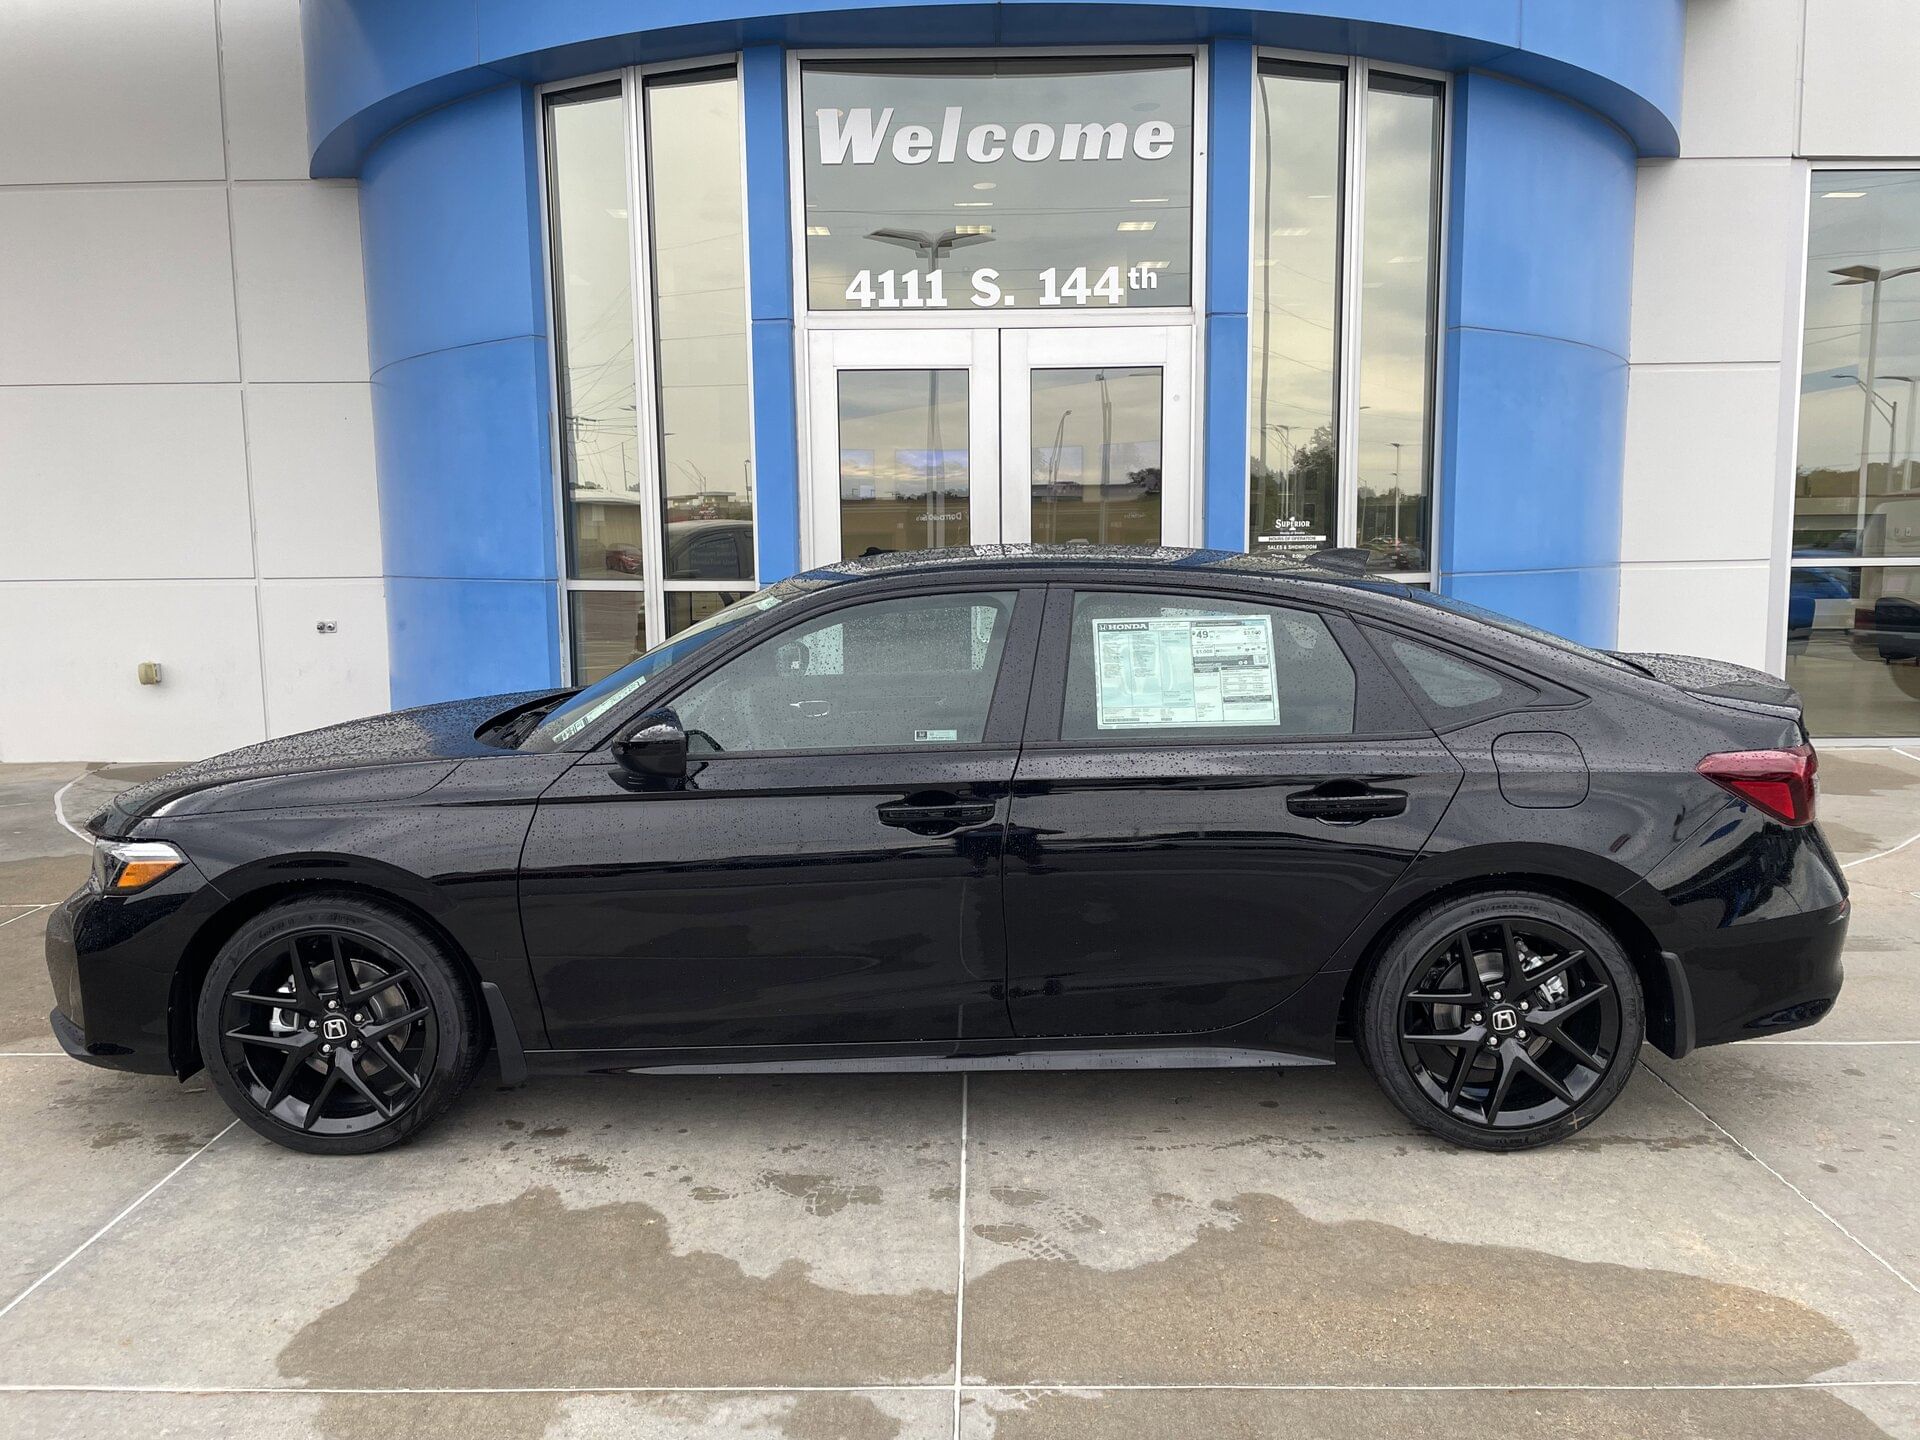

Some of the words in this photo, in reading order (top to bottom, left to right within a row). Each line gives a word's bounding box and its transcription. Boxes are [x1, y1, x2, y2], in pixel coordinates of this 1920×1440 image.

[817, 106, 1175, 165] Welcome
[845, 269, 948, 308] 4111
[970, 268, 1015, 307] S.
[1039, 265, 1158, 306] 144th
[1108, 623, 1148, 631] HONDA
[1196, 630, 1209, 639] 49
